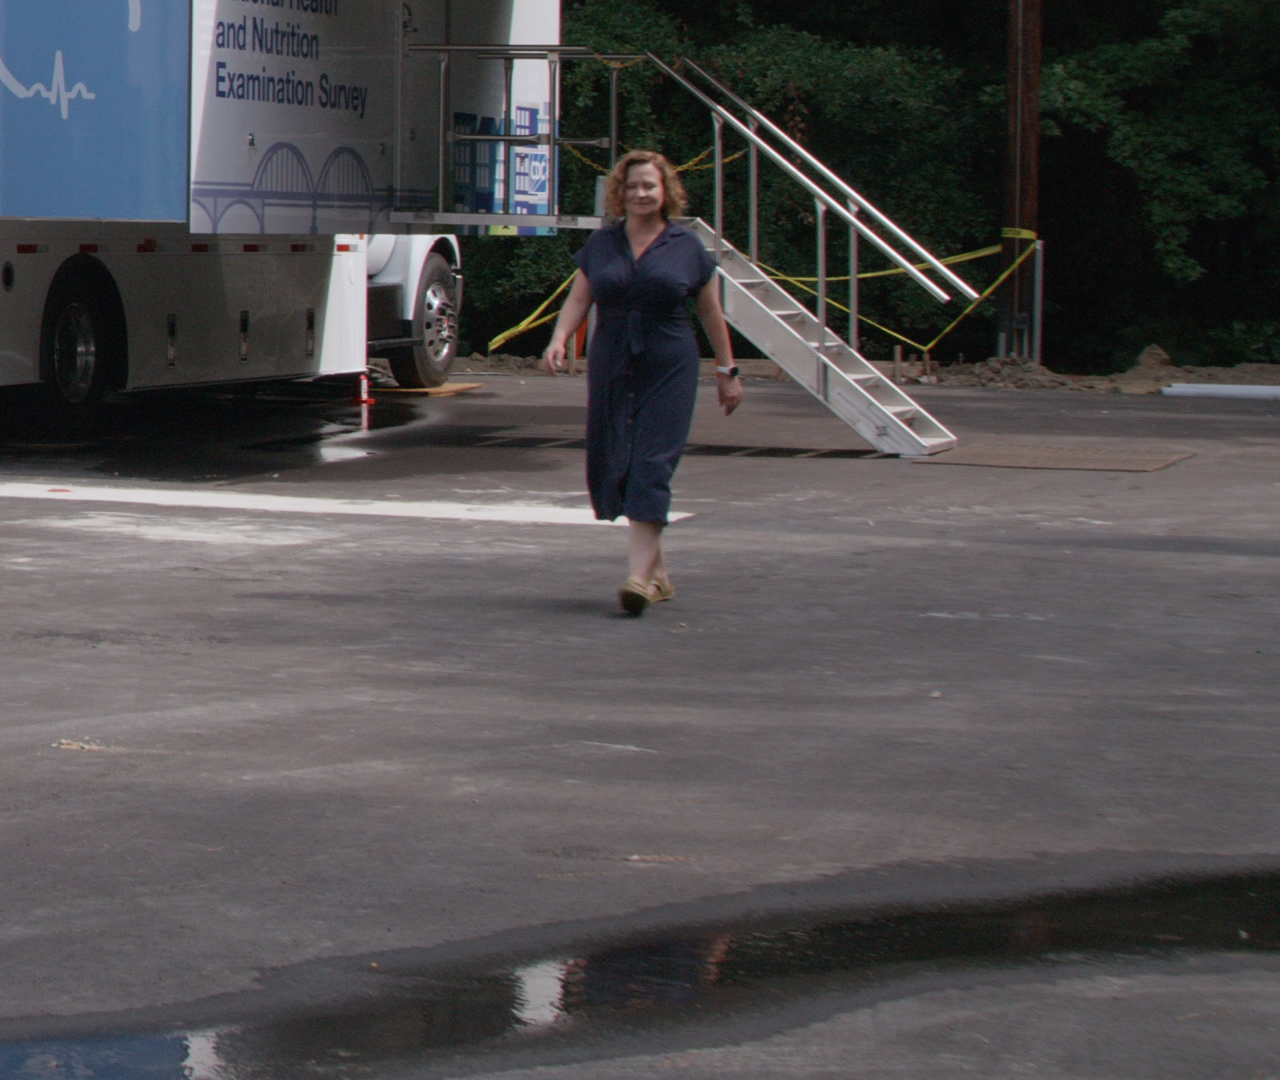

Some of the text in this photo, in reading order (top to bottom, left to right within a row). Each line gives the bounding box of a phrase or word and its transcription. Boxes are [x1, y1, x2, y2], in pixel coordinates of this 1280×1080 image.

[215, 15, 319, 60] and Nutrition
[215, 61, 368, 120] Examination Survey
